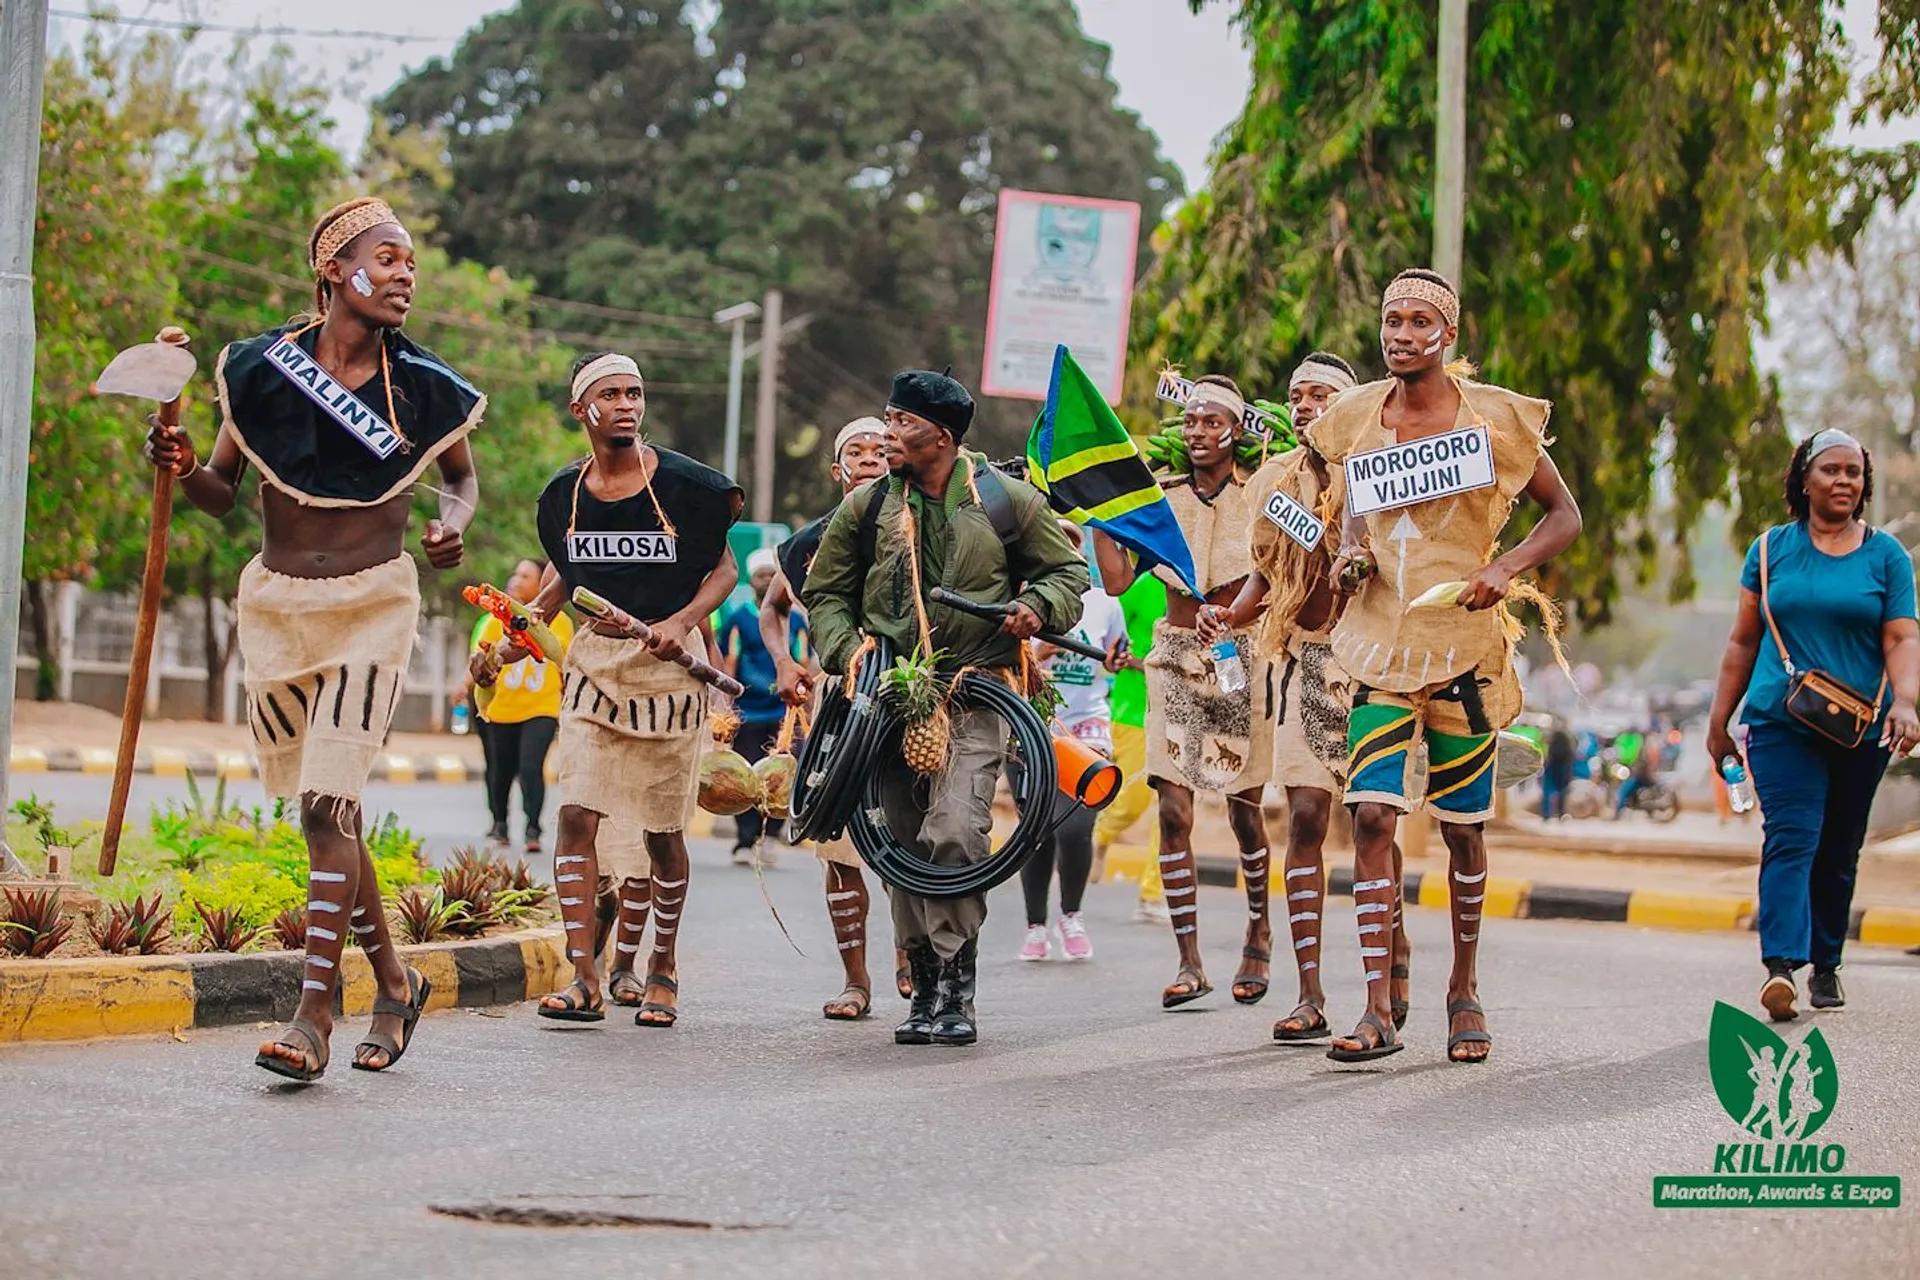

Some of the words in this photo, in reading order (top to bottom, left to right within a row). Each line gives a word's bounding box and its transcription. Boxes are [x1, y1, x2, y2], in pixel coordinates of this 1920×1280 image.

[274, 343, 396, 450] MALINYI
[1353, 432, 1480, 482] MOROGORO
[1373, 464, 1461, 503] VIJIJINI
[1268, 495, 1319, 543] GAIRO
[575, 537, 670, 557] KILOSA
